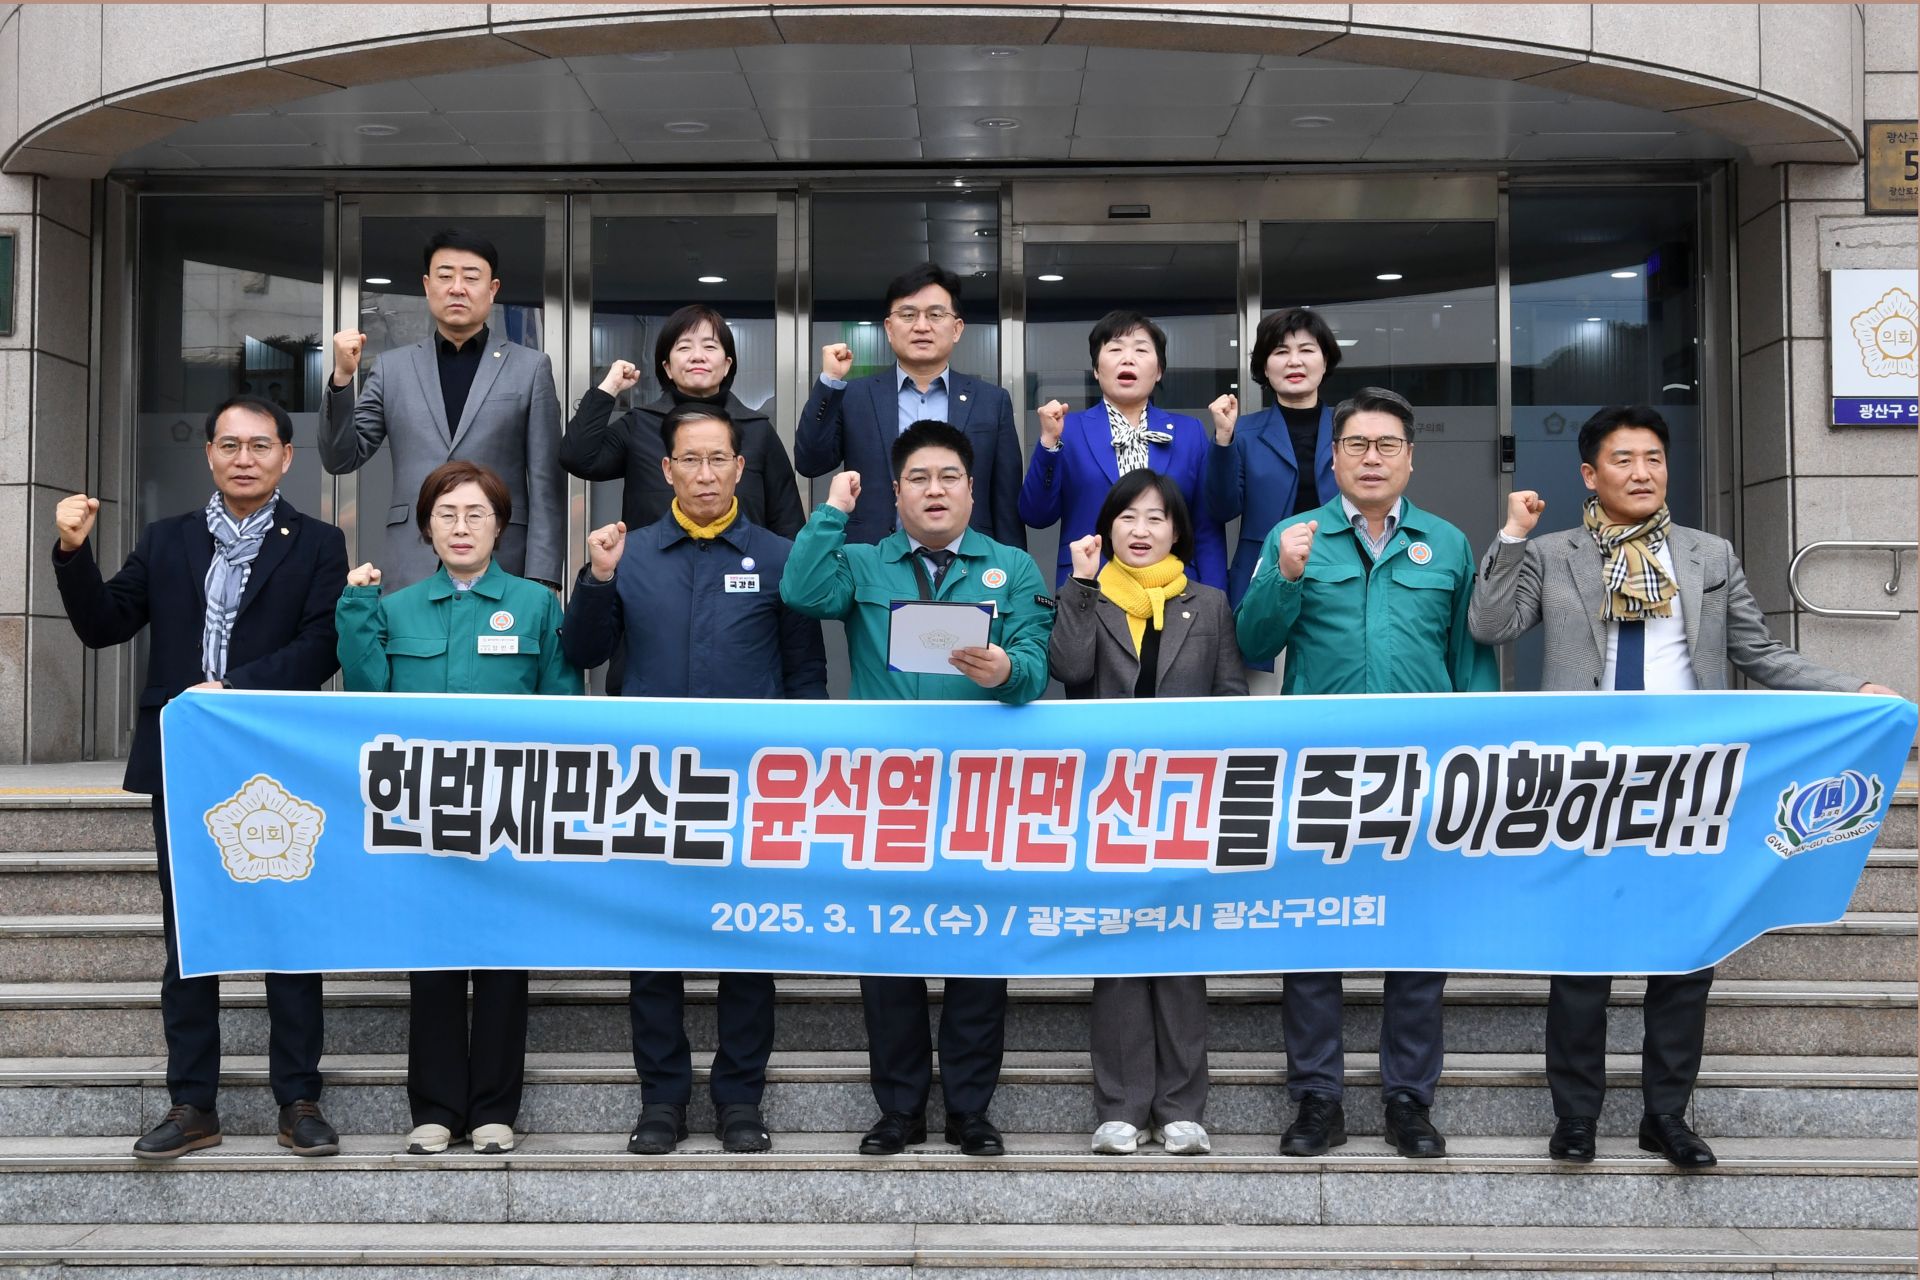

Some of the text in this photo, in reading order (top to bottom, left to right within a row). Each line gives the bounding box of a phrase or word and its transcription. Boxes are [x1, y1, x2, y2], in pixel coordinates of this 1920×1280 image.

[1882, 329, 1912, 346] 의회
[1859, 404, 1903, 419] 광산구
[1415, 423, 1445, 433] 구의회
[367, 741, 1742, 866] 헌법재판소는 윤석열 파면 선고를 즉각 이행하라!!
[246, 824, 285, 844] 의회
[1767, 823, 1878, 856] GWAN-GU COUNCIL
[711, 894, 1387, 937] 2025. 3. 12.(수) / 광주광역시 광산구의회
